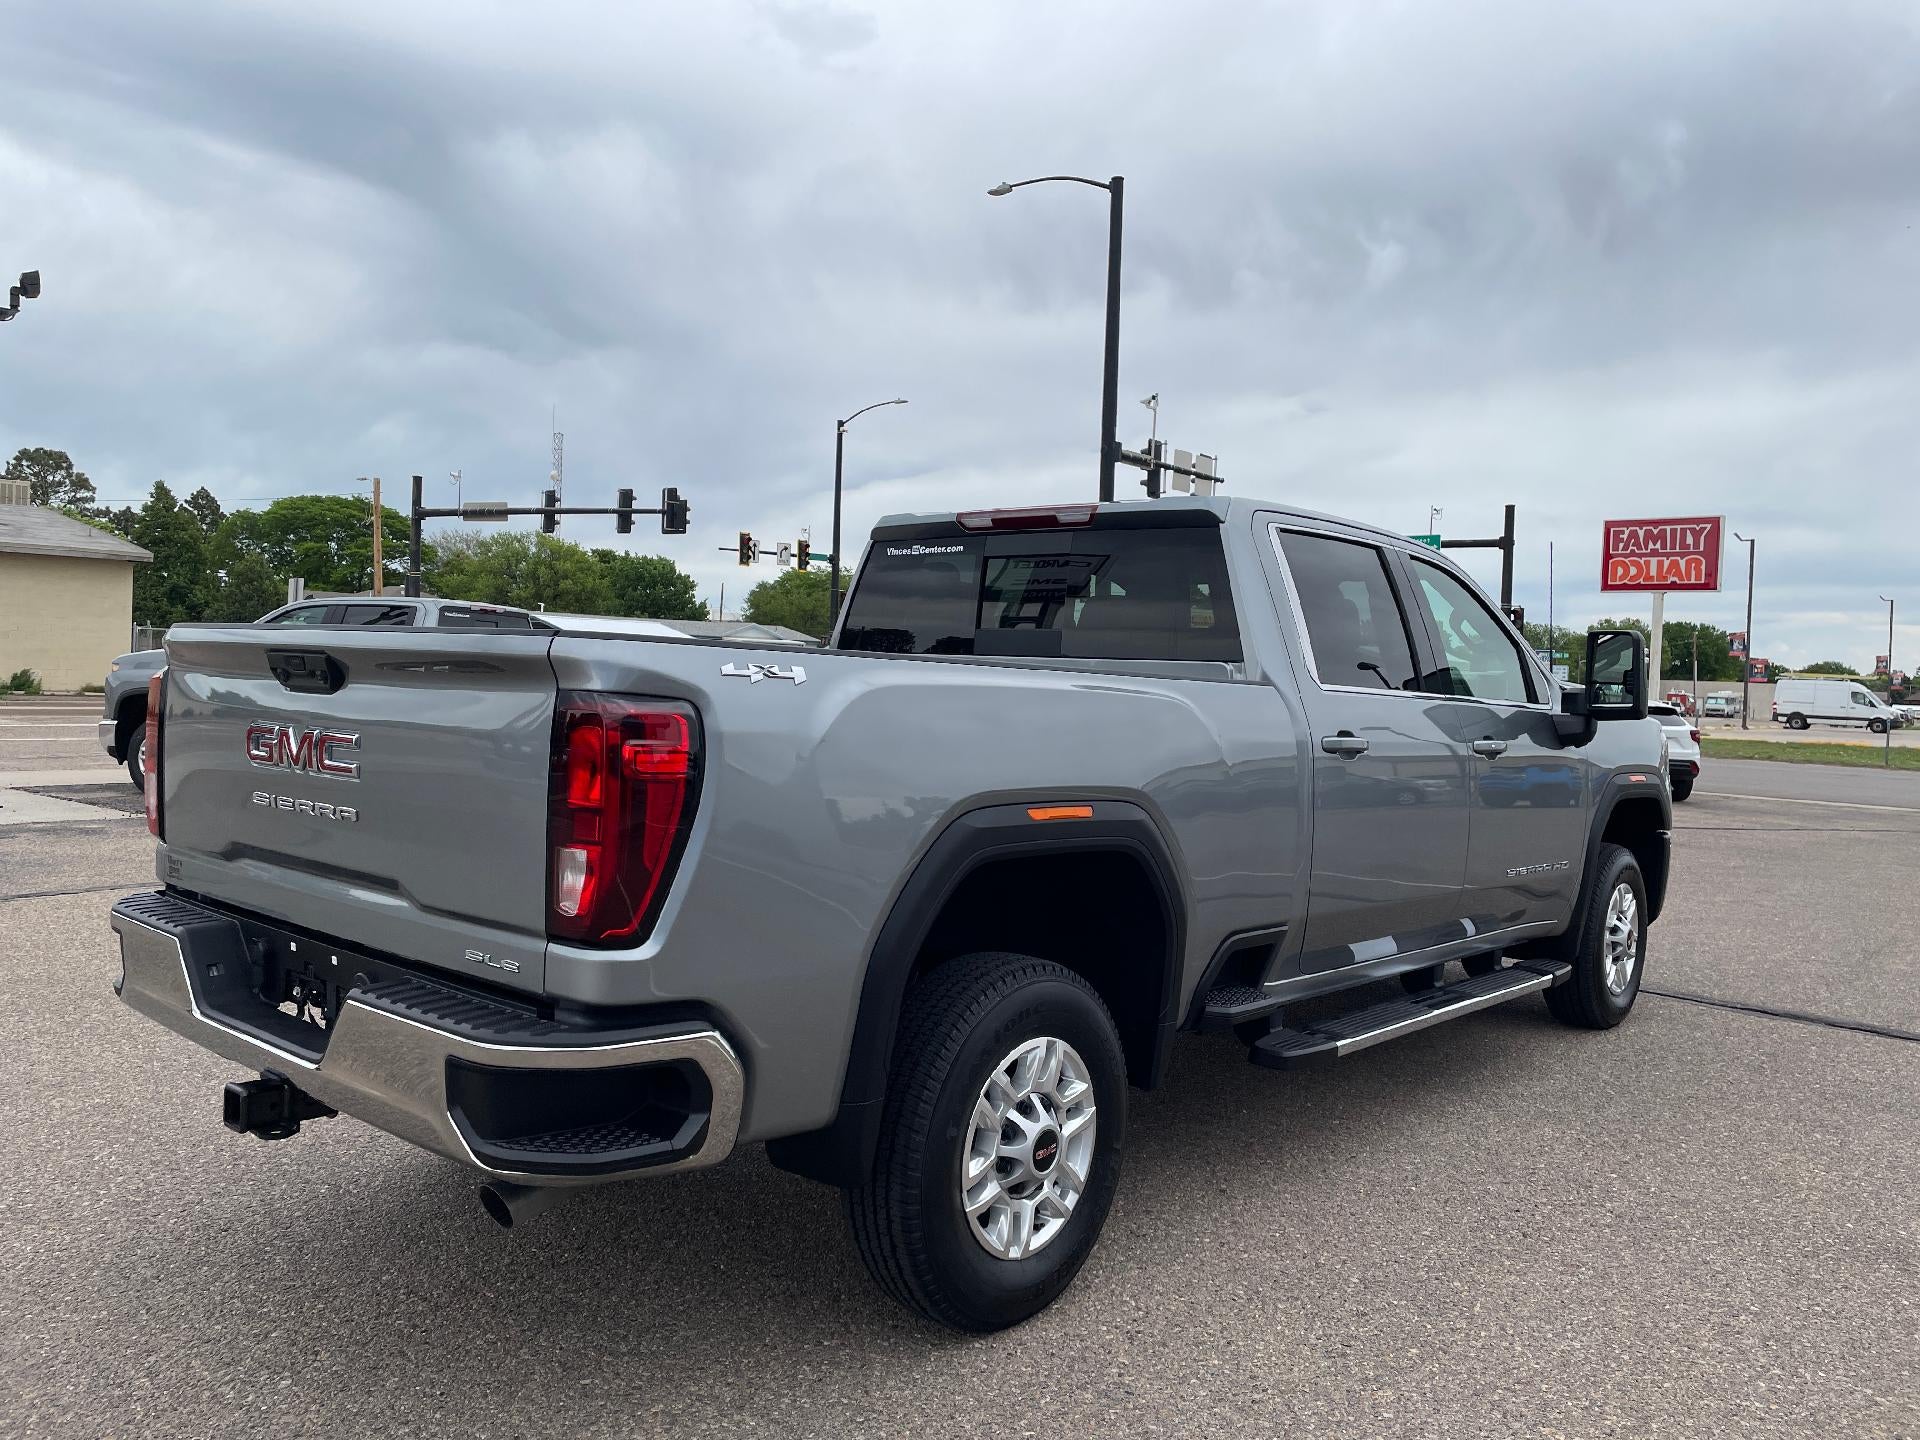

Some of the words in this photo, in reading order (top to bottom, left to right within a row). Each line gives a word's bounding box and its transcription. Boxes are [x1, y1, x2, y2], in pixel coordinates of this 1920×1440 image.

[1609, 523, 1712, 554] FAMILY
[1608, 555, 1706, 584] DOLLAR
[246, 722, 361, 780] GMC
[252, 791, 359, 821] SIERRA
[1506, 863, 1551, 877] SIERRA
[1552, 861, 1569, 871] HD
[1036, 1143, 1057, 1159] GMC
